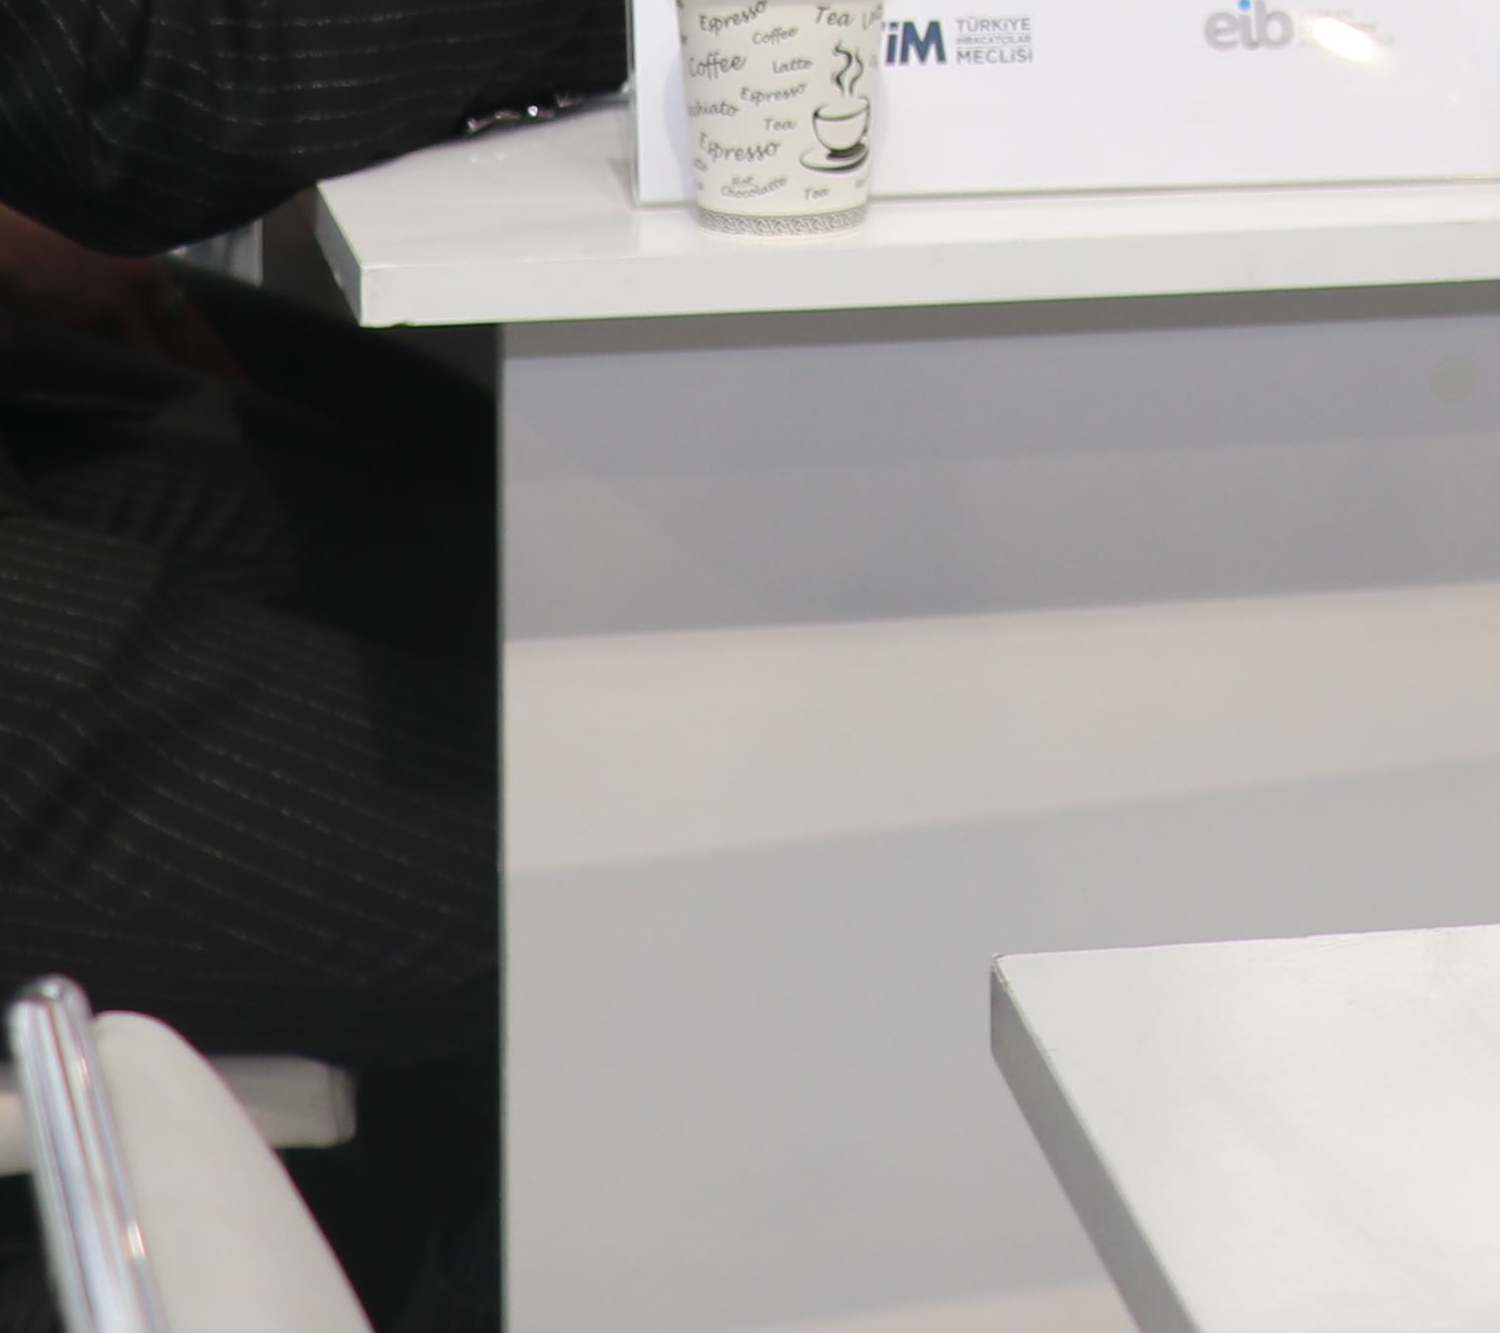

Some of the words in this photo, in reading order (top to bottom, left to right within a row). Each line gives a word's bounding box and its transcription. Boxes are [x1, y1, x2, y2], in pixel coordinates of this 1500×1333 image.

[815, 5, 854, 27] Tea
[751, 26, 799, 45] Coffee
[688, 52, 747, 79] Coffee
[772, 58, 813, 75] Latte
[739, 83, 808, 106] Espresso
[763, 118, 798, 132] Tea
[699, 133, 782, 163] Espresso
